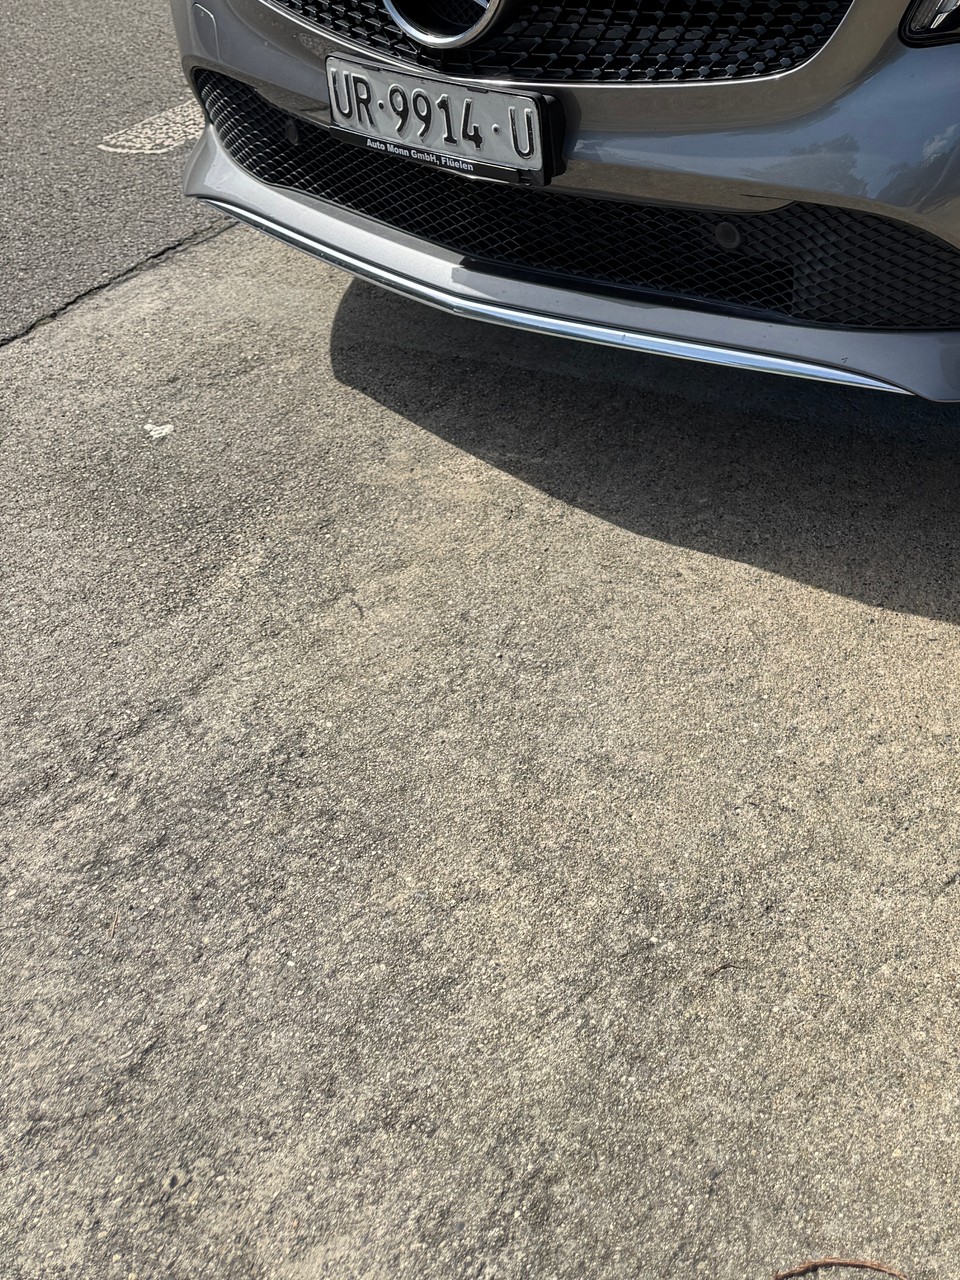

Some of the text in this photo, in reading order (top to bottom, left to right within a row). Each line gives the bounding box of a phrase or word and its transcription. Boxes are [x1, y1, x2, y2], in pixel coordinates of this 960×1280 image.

[366, 138, 475, 172] Auto Monn GmbH, Flüelen
